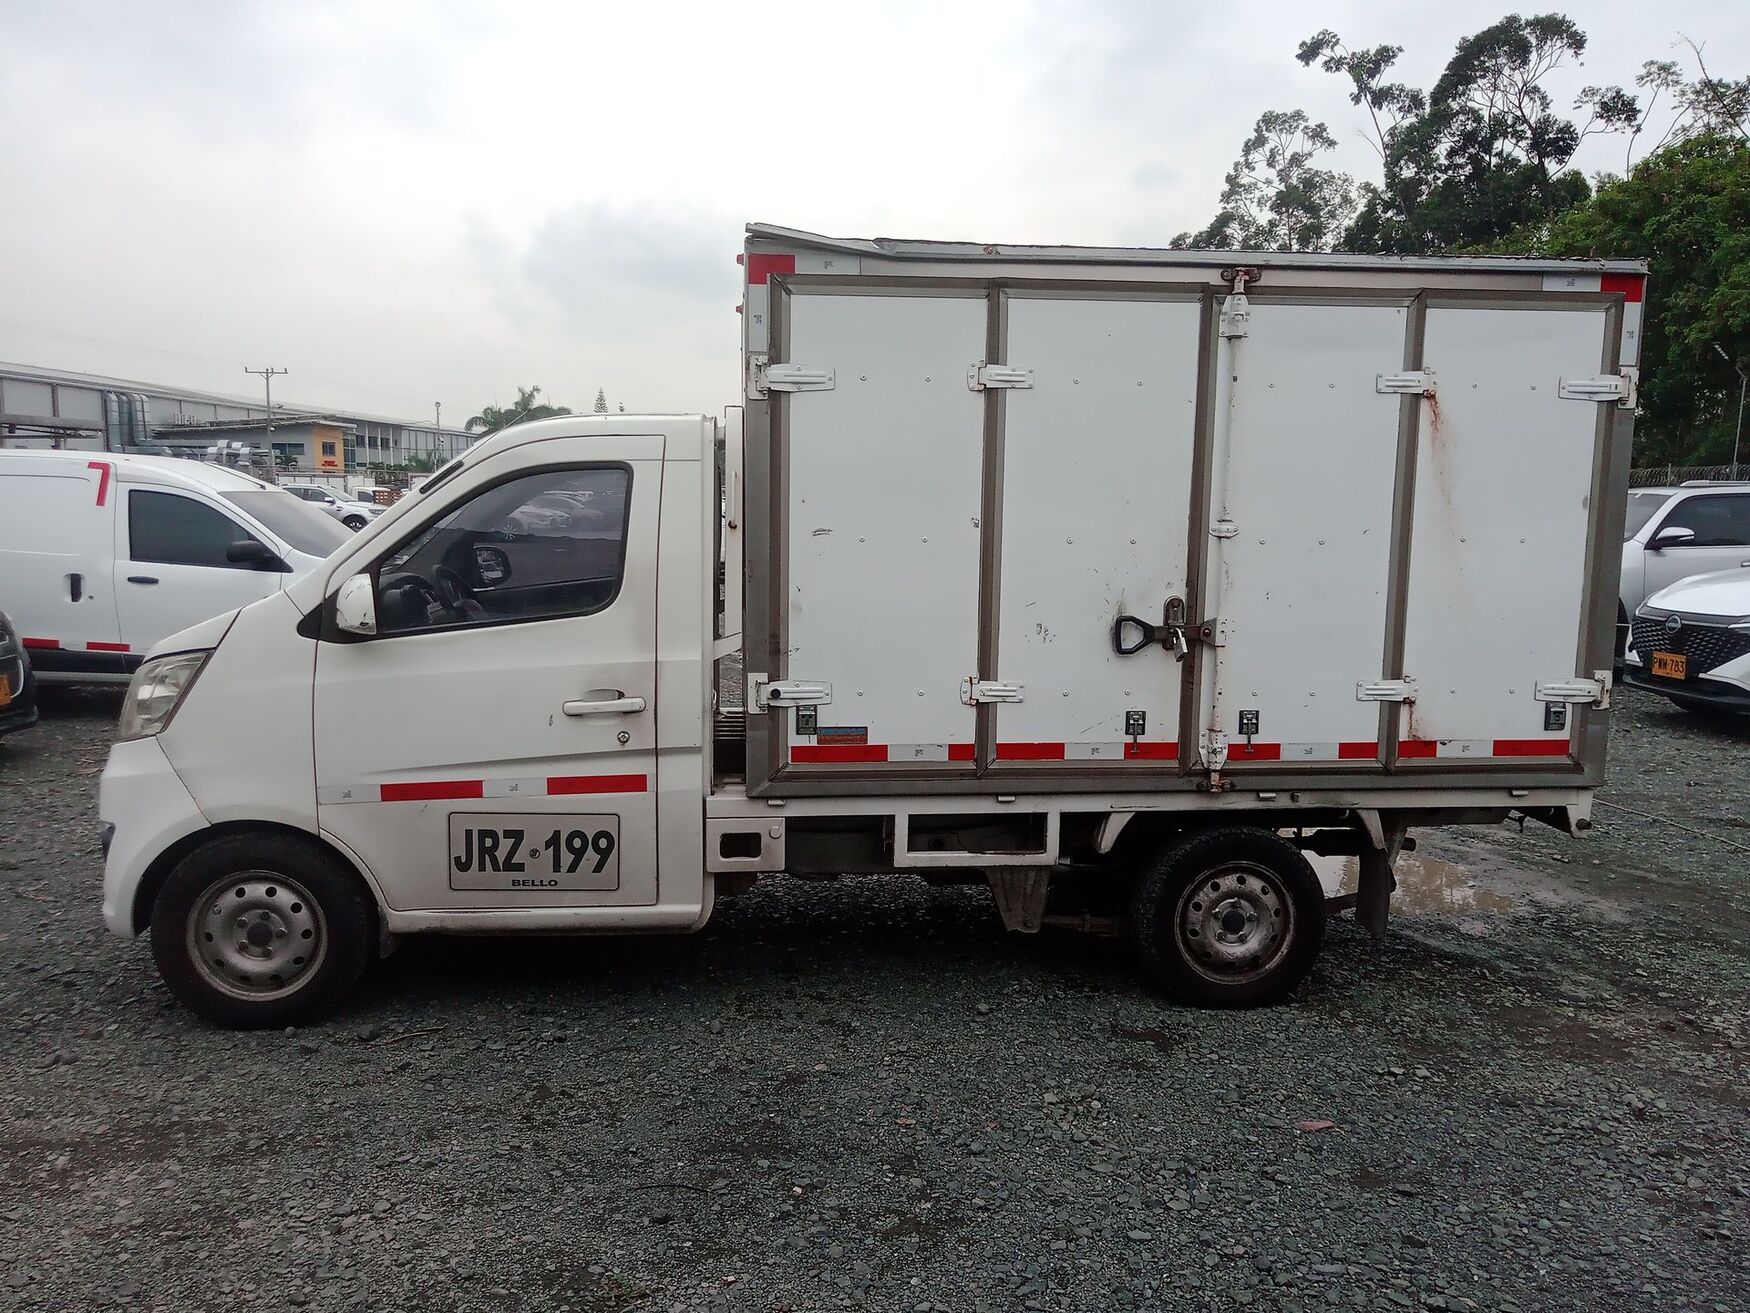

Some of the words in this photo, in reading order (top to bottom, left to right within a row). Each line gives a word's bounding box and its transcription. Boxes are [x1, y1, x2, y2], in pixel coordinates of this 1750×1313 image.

[454, 829, 525, 873] JRZ
[544, 829, 616, 874] 199
[511, 879, 558, 887] BELLO
